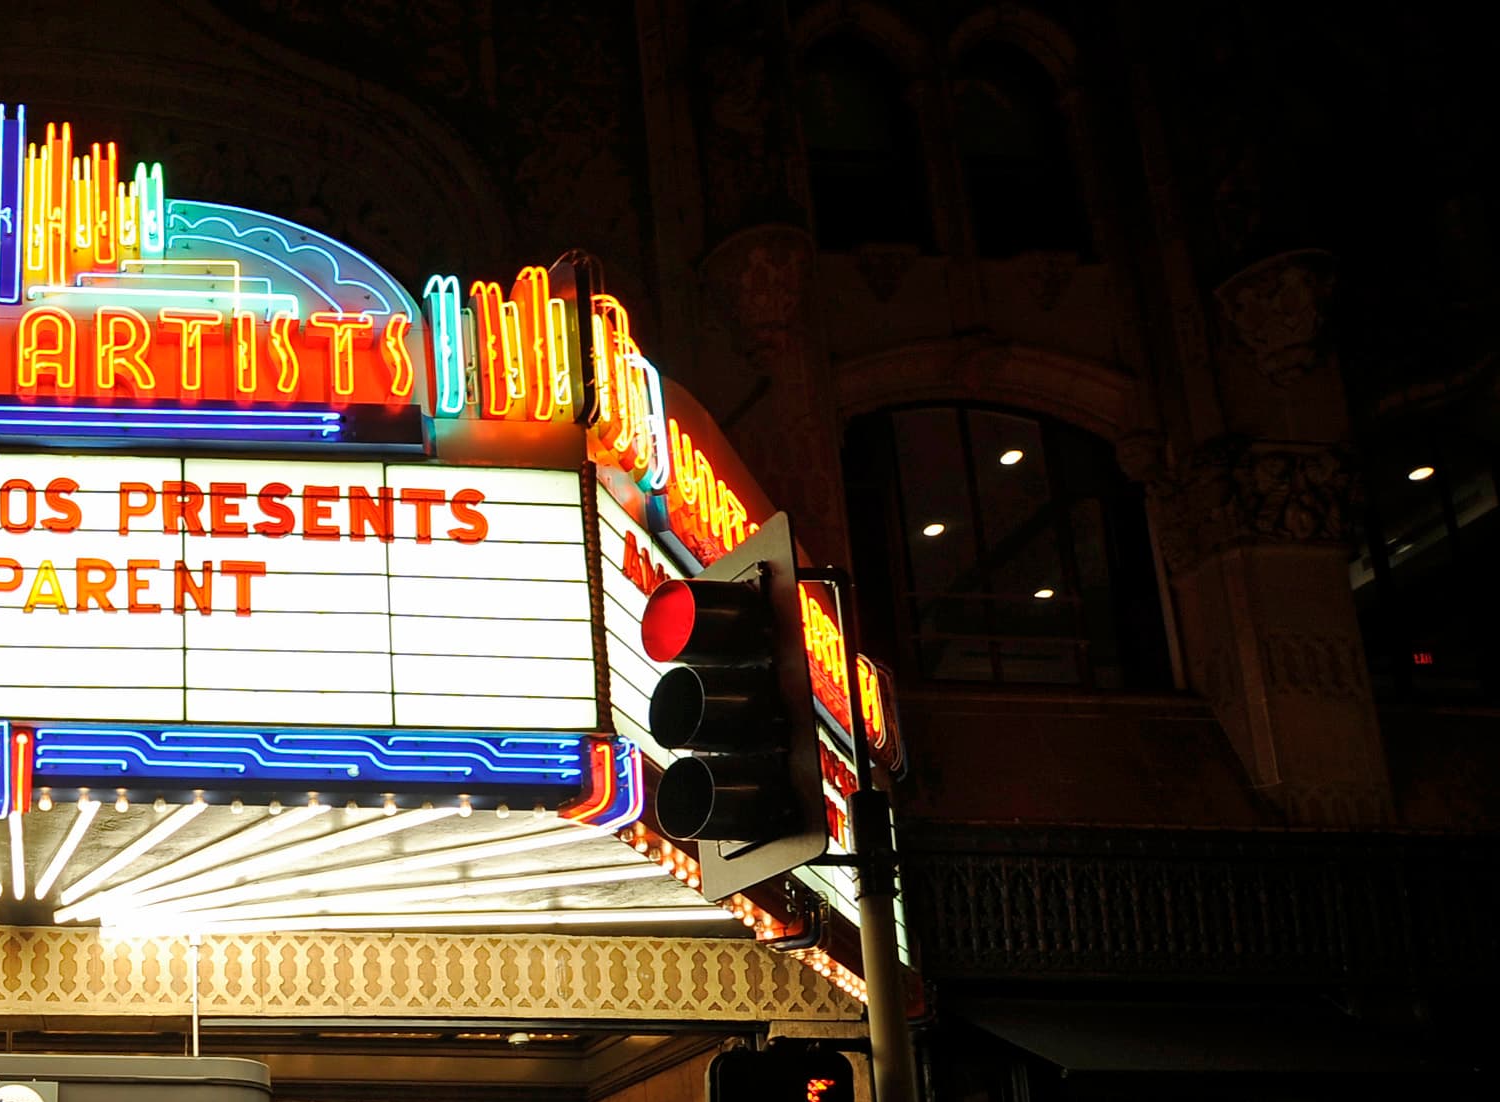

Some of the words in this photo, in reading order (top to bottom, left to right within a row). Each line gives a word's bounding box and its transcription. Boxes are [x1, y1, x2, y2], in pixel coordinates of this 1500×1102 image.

[16, 305, 416, 402] ARTISTS
[118, 480, 491, 544] PRESENTS
[668, 418, 760, 552] UNIT
